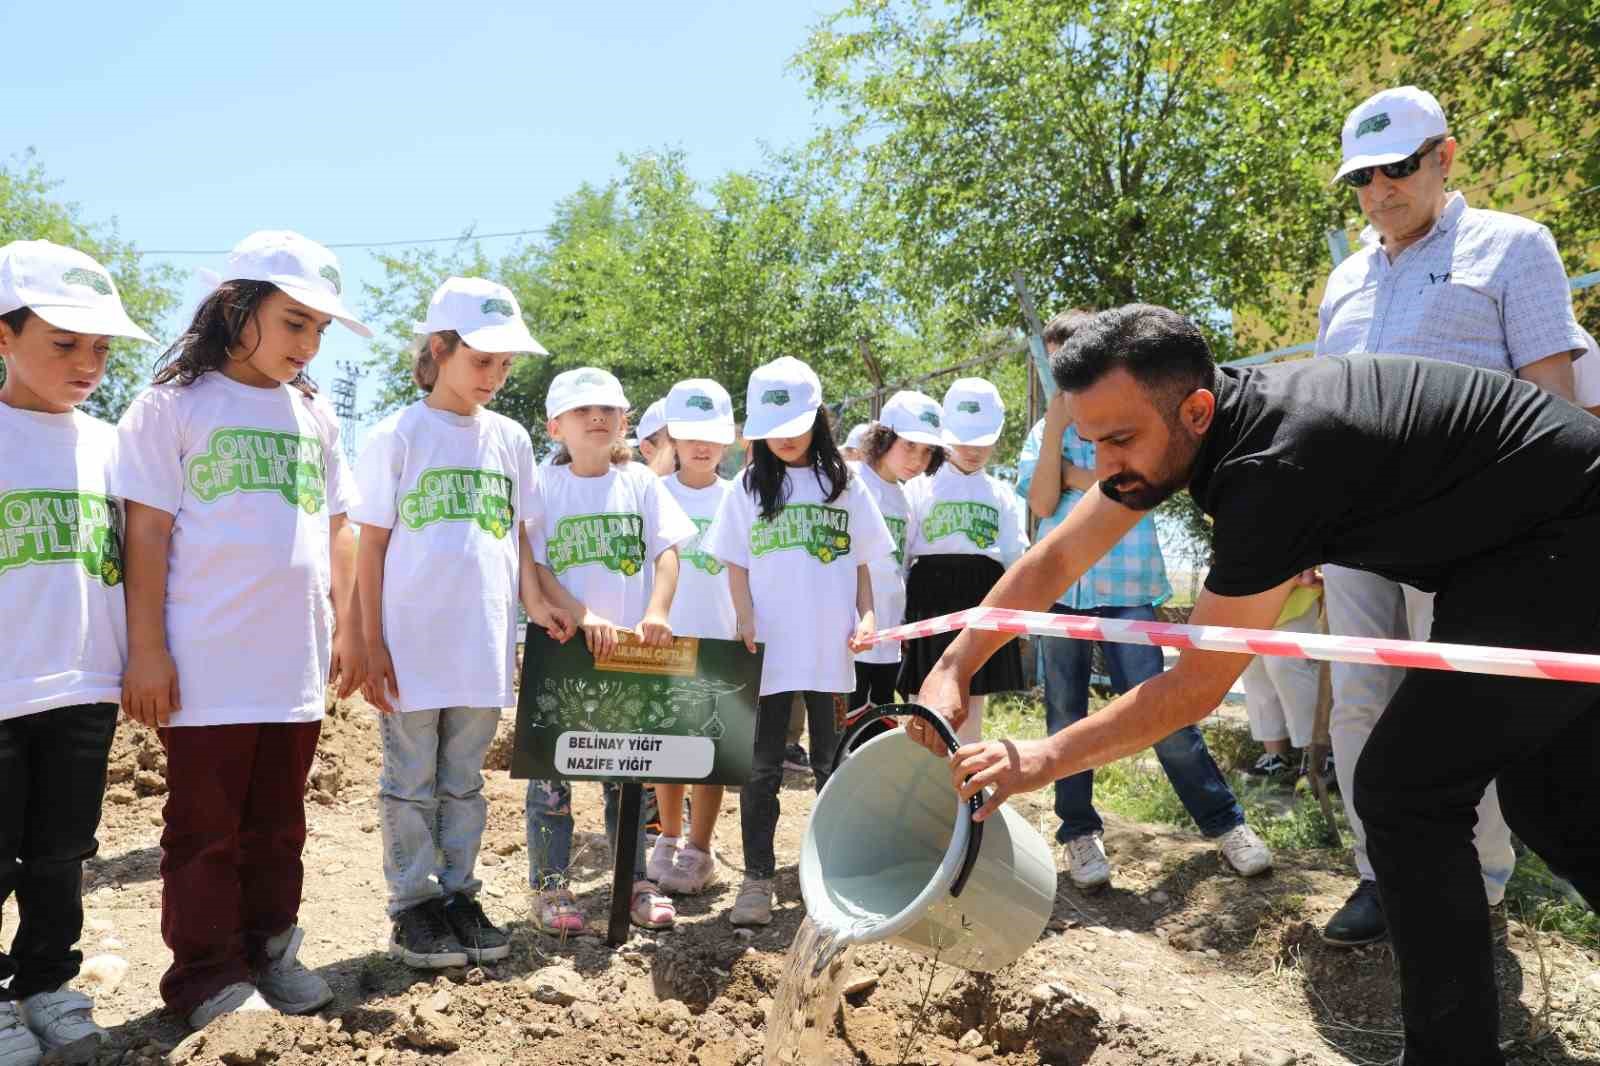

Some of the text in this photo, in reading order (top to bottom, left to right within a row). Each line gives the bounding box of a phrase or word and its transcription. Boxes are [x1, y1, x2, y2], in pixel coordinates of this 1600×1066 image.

[424, 473, 510, 497] OKULDA
[768, 506, 848, 532] KULDAKİ
[0, 523, 97, 559] İFTLİK
[568, 733, 663, 752] BELİNAY YİĞİT
[567, 754, 653, 772] NAZİFE YİĞİT
